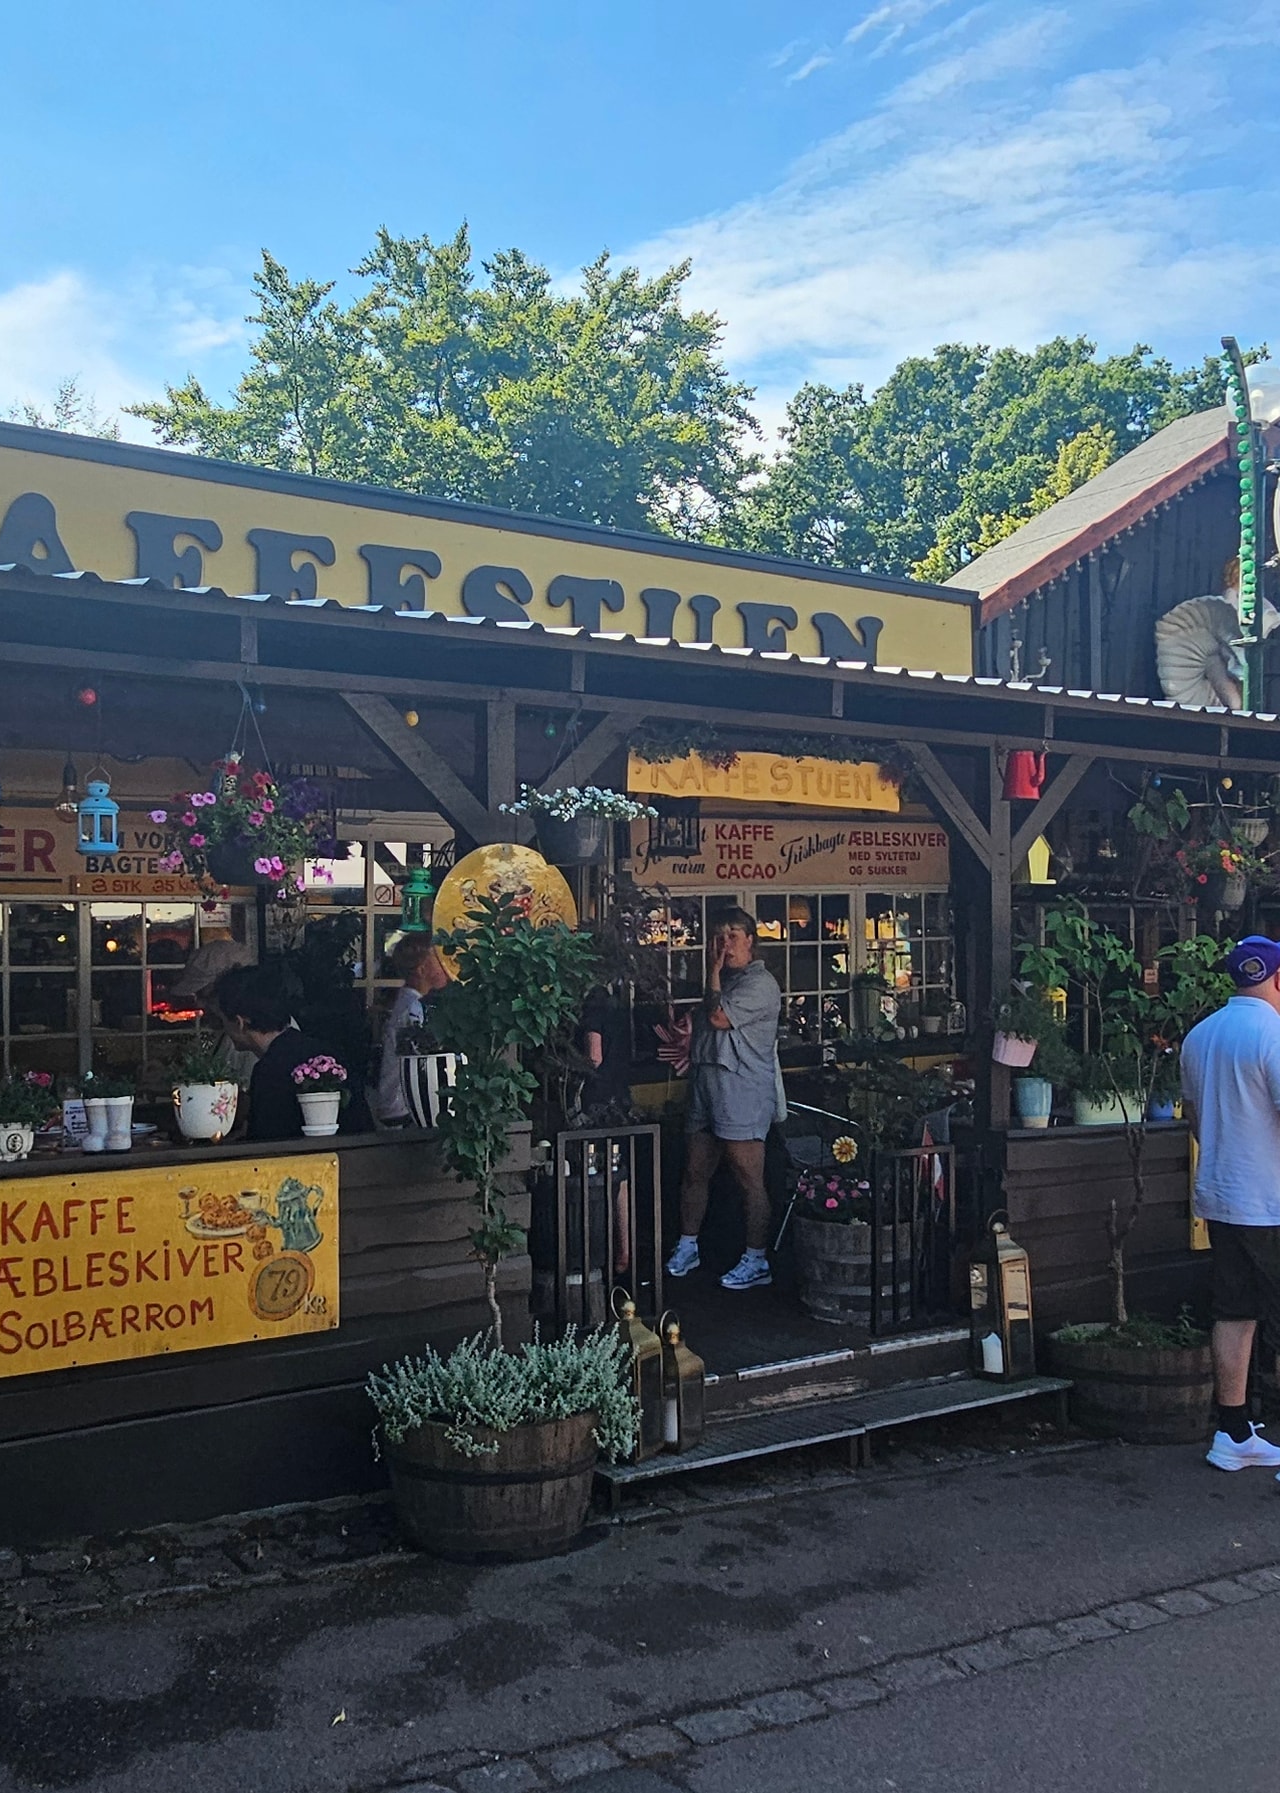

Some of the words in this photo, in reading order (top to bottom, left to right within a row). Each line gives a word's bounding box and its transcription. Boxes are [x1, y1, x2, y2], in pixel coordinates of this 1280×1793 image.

[651, 761, 761, 794] KAFFE
[769, 760, 873, 802] STUEN
[714, 823, 774, 842] KAFFE
[847, 830, 947, 848] ÆBLESKIVER
[716, 843, 753, 860] THE
[848, 851, 870, 862] MED
[85, 856, 158, 874] BAGTE
[715, 863, 777, 880] CACAO
[849, 866, 863, 876] OG
[867, 866, 908, 876] SUKKER
[112, 879, 142, 893] STK
[0, 1196, 137, 1246] KAFFE
[269, 1268, 300, 1299] 79
[303, 1292, 328, 1315] KR
